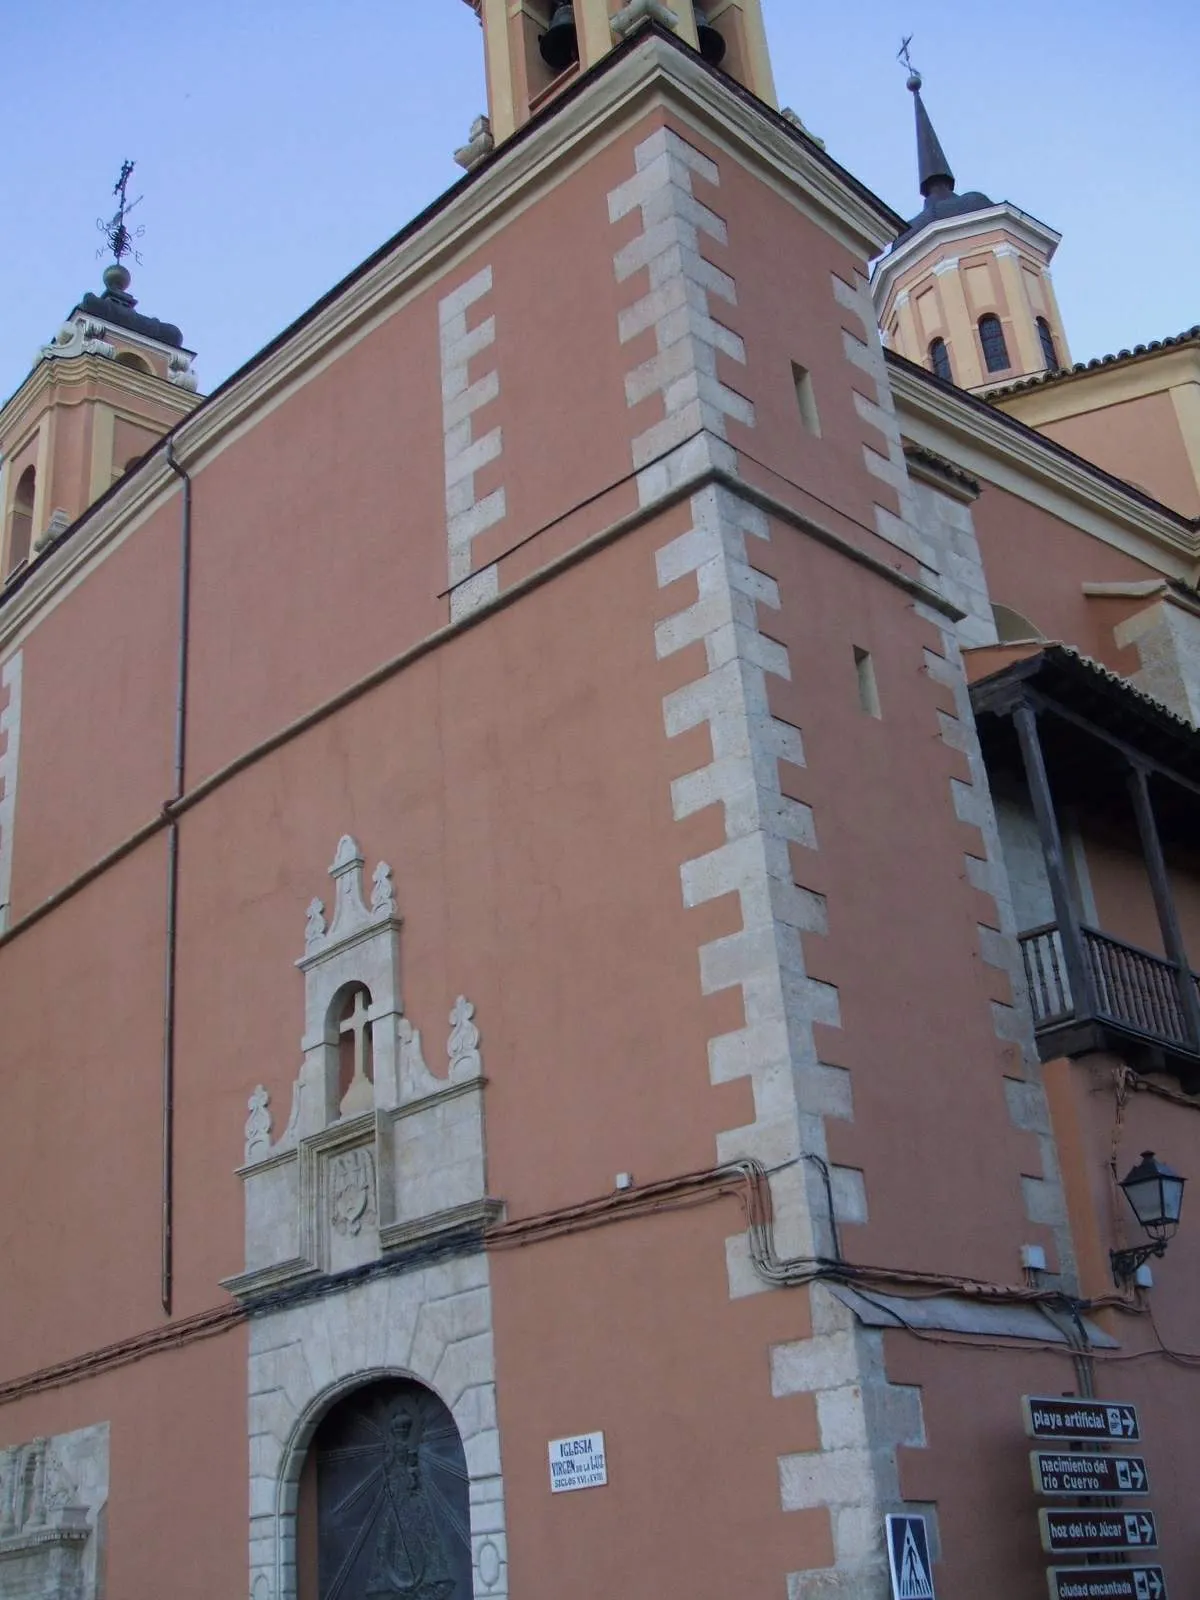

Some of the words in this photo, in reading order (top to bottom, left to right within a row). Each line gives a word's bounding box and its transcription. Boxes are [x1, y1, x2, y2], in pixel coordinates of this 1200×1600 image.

[1033, 1410, 1062, 1429] playa
[1065, 1411, 1106, 1429] artificial
[560, 1438, 593, 1457] IGLESIA
[552, 1459, 576, 1477] VIRGEN
[590, 1454, 604, 1470] LUZ
[1042, 1458, 1093, 1473] nacimiento
[1094, 1459, 1108, 1474] del
[1063, 1474, 1099, 1489] Cuervo
[1050, 1523, 1068, 1538] hoz
[1069, 1522, 1084, 1537] del
[1099, 1521, 1121, 1536] Júcar
[1060, 1583, 1088, 1597] ciudad
[1090, 1580, 1132, 1596] encantada
